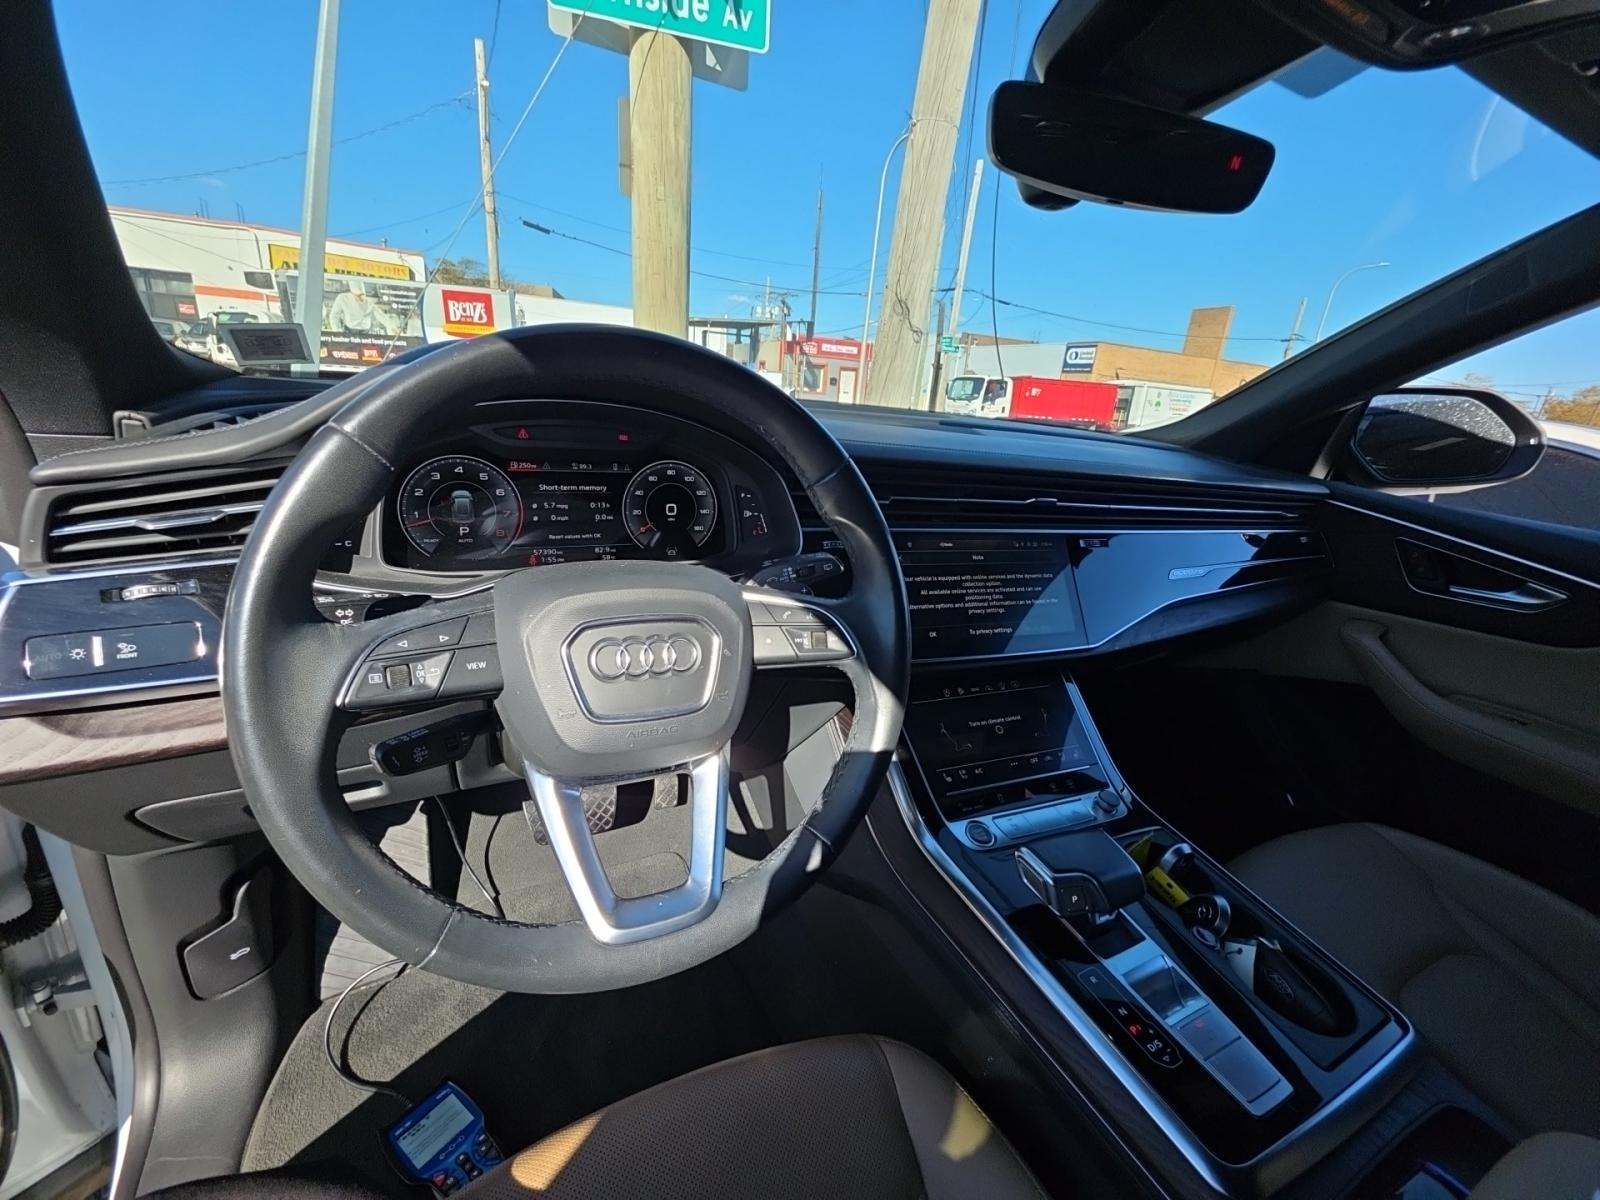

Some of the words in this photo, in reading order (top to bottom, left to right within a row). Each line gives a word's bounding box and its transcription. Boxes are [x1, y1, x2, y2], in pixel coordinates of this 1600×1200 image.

[722, 5, 753, 32] Av
[454, 466, 464, 474] 4
[430, 472, 441, 481] 3
[479, 472, 489, 481] 5
[684, 475, 695, 483] 100
[414, 488, 425, 496] 2
[496, 488, 506, 496] 6
[539, 484, 578, 492] Short-term
[578, 485, 608, 493] memory
[665, 503, 677, 516] 0
[459, 526, 470, 537] P
[496, 529, 505, 537] 8
[466, 661, 487, 671] VIEW
[626, 727, 679, 738] AIRBAG
[1072, 894, 1079, 904] P
[1147, 1039, 1163, 1053] D/S
